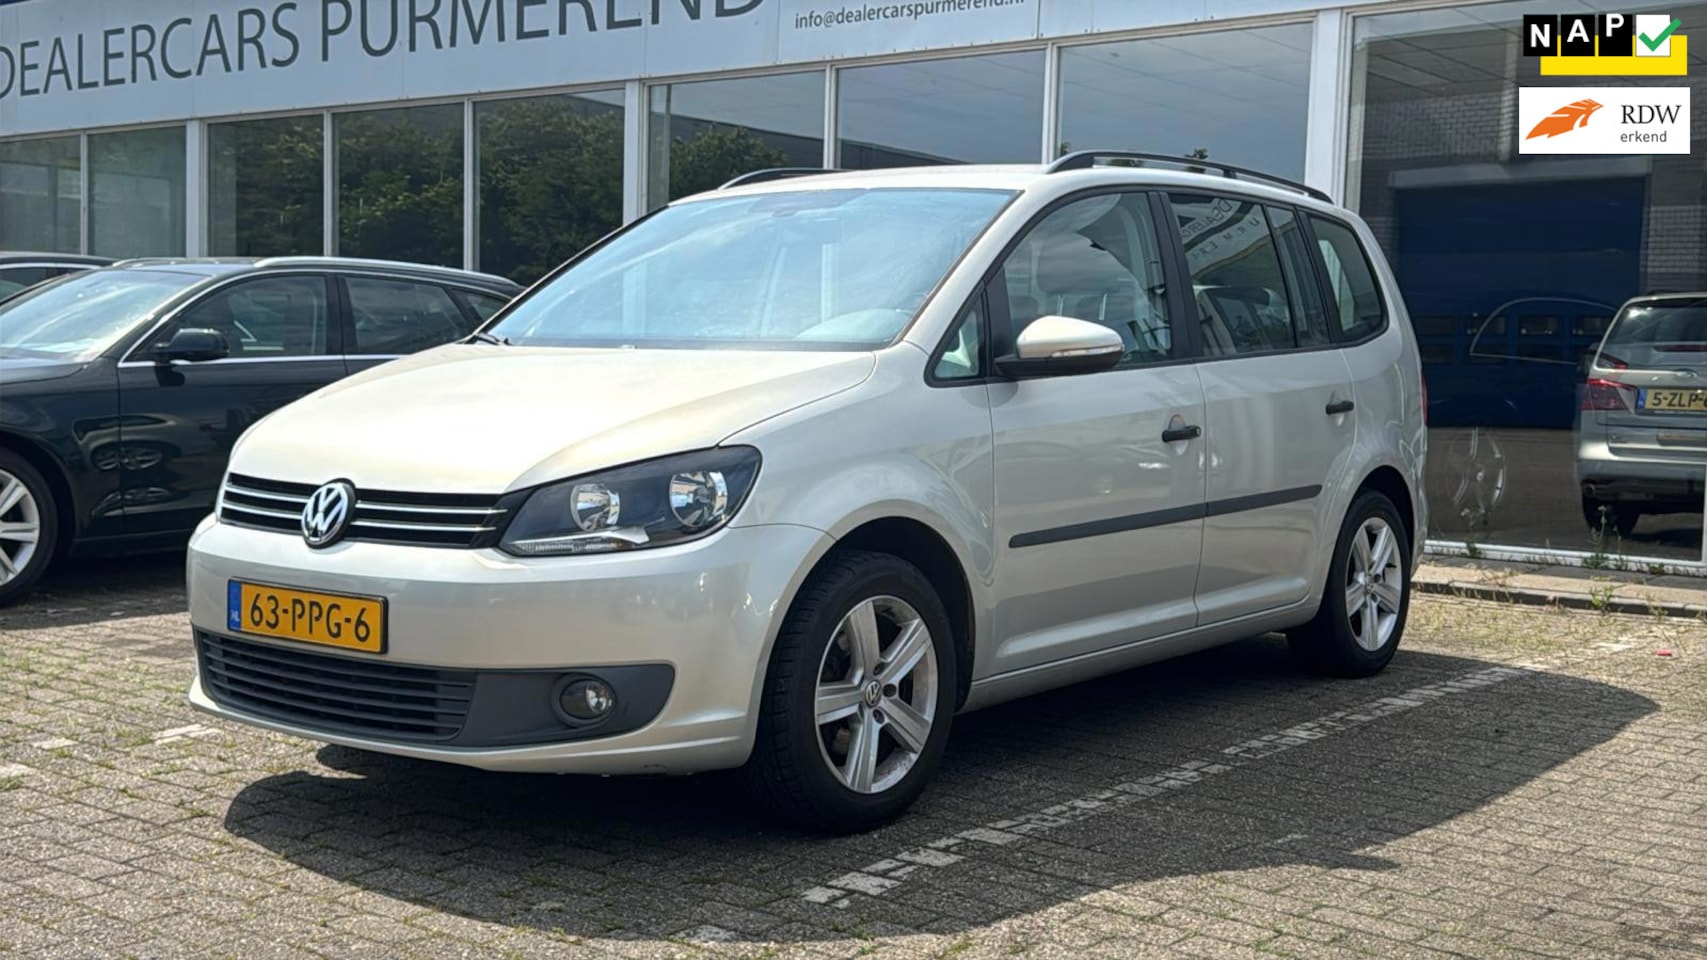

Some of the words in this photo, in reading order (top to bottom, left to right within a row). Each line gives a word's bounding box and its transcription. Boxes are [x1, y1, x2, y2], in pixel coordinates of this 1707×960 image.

[0, 2, 299, 99] DEALERCARS
[321, 0, 765, 62] PURME
[250, 593, 370, 643] 63-PPG-6
